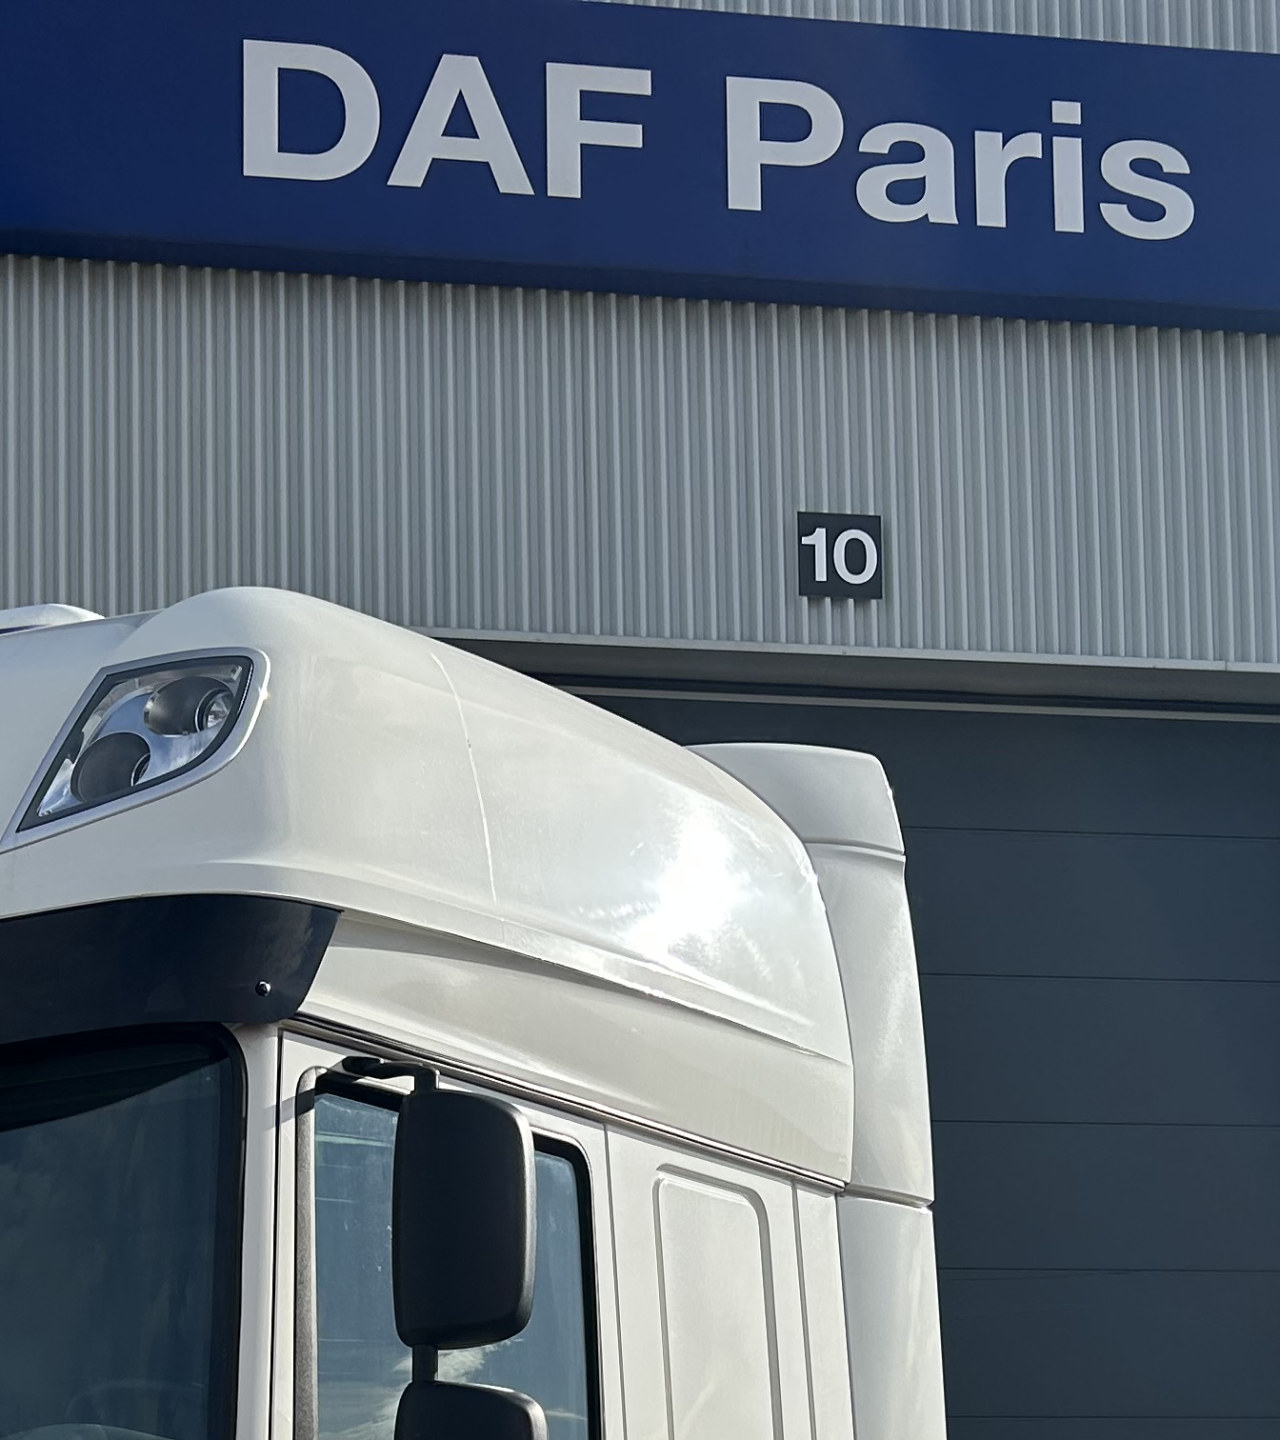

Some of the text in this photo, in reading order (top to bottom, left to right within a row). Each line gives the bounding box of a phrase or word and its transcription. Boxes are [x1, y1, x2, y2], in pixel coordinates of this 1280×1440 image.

[243, 38, 1195, 239] DAF Paris
[801, 527, 878, 585] 10
